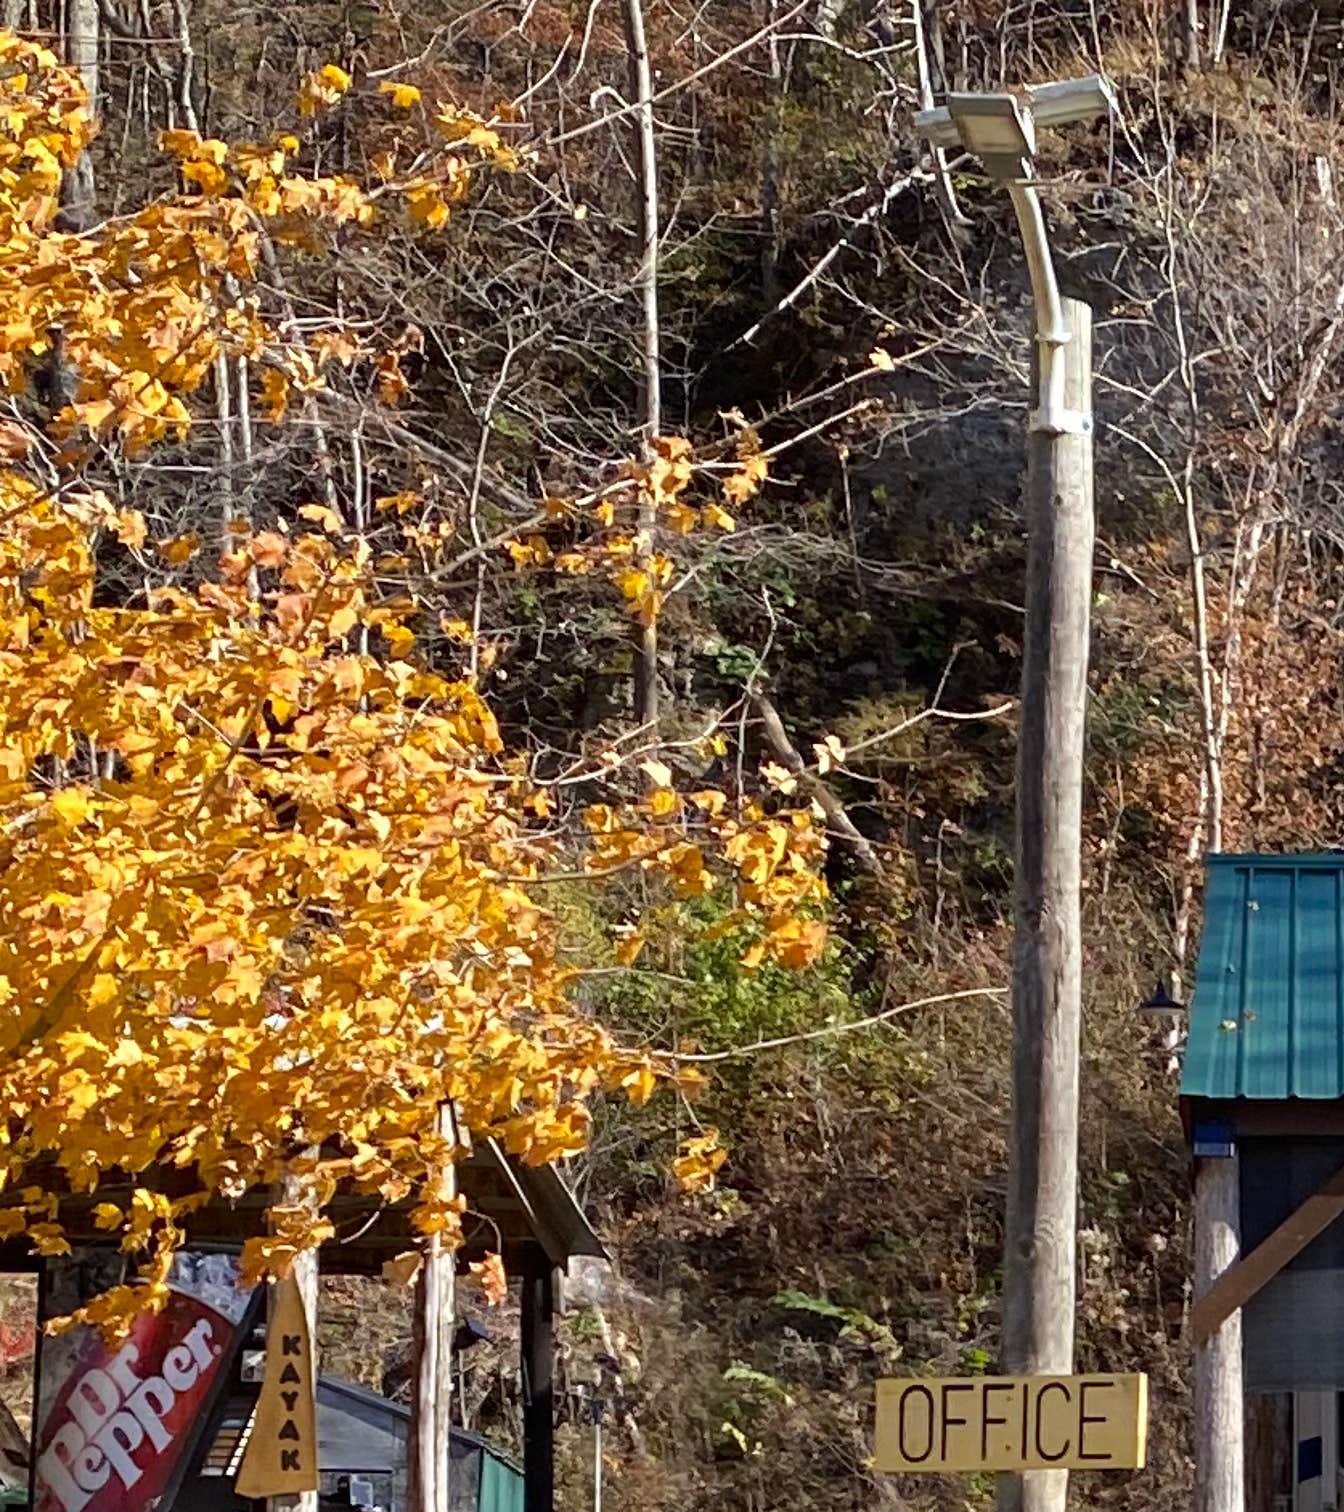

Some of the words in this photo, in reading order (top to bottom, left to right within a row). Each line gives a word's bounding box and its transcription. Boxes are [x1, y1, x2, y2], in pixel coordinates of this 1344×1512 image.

[66, 1343, 144, 1431] Dr
[278, 1334, 302, 1472] KAYAK
[898, 1381, 1115, 1463] OFFICE
